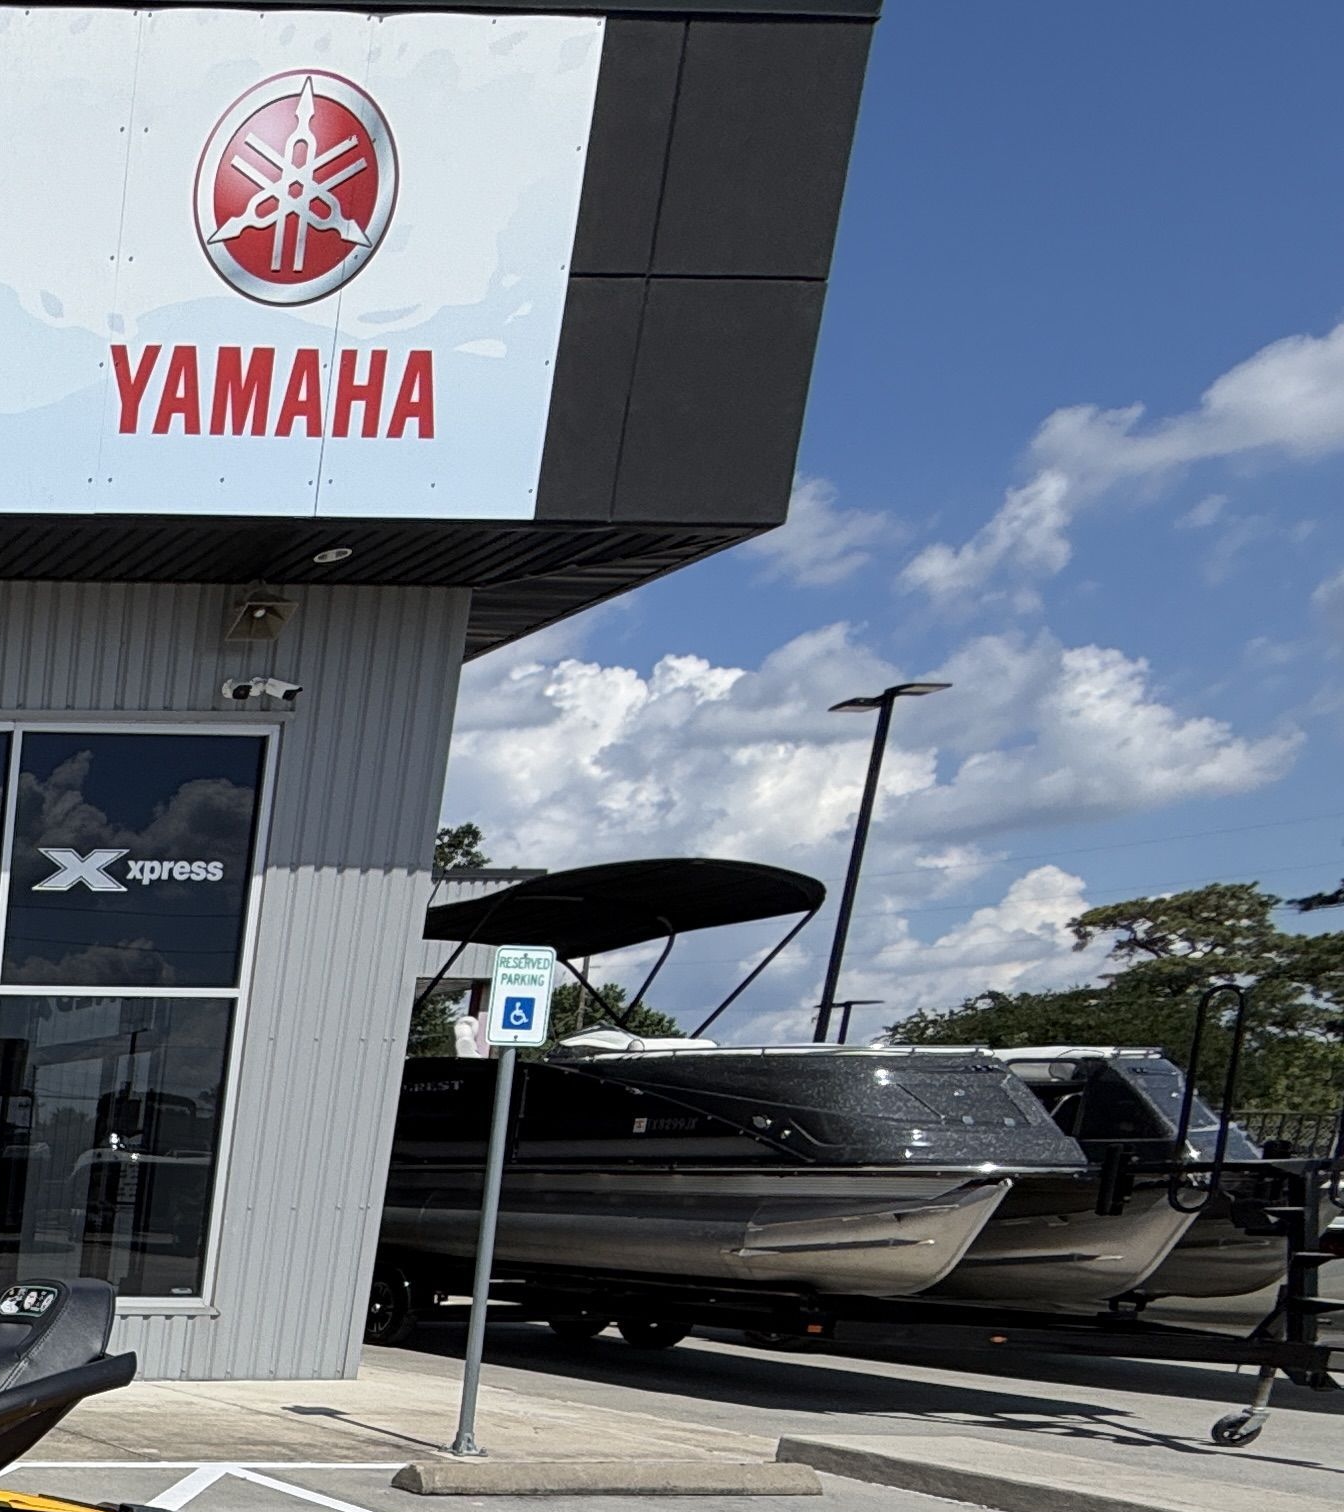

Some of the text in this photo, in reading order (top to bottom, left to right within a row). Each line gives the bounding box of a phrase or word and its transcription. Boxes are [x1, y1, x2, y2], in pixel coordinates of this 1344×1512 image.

[111, 344, 435, 440] YAMAHA
[126, 860, 224, 886] xpress
[499, 956, 550, 970] RESERVED
[500, 972, 545, 986] PARKING
